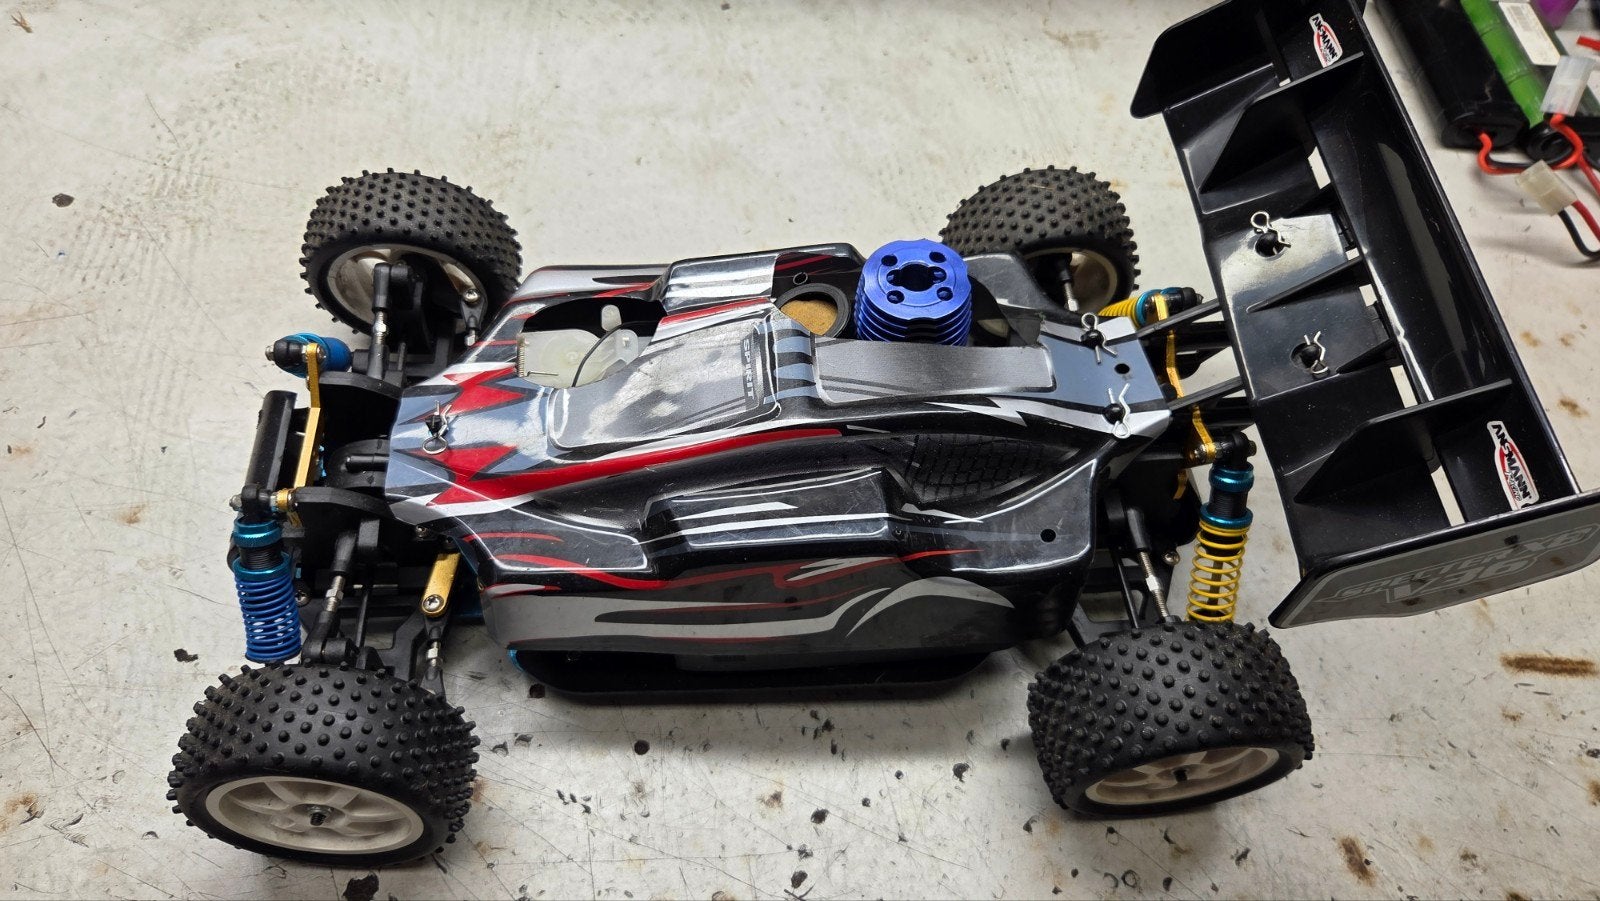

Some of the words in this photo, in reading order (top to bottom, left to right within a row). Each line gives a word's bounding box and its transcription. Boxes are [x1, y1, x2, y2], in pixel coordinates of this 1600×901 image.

[1311, 15, 1338, 60] ANSMANN
[743, 338, 755, 400] SPIRIT
[1491, 424, 1531, 499] ANSMANN
